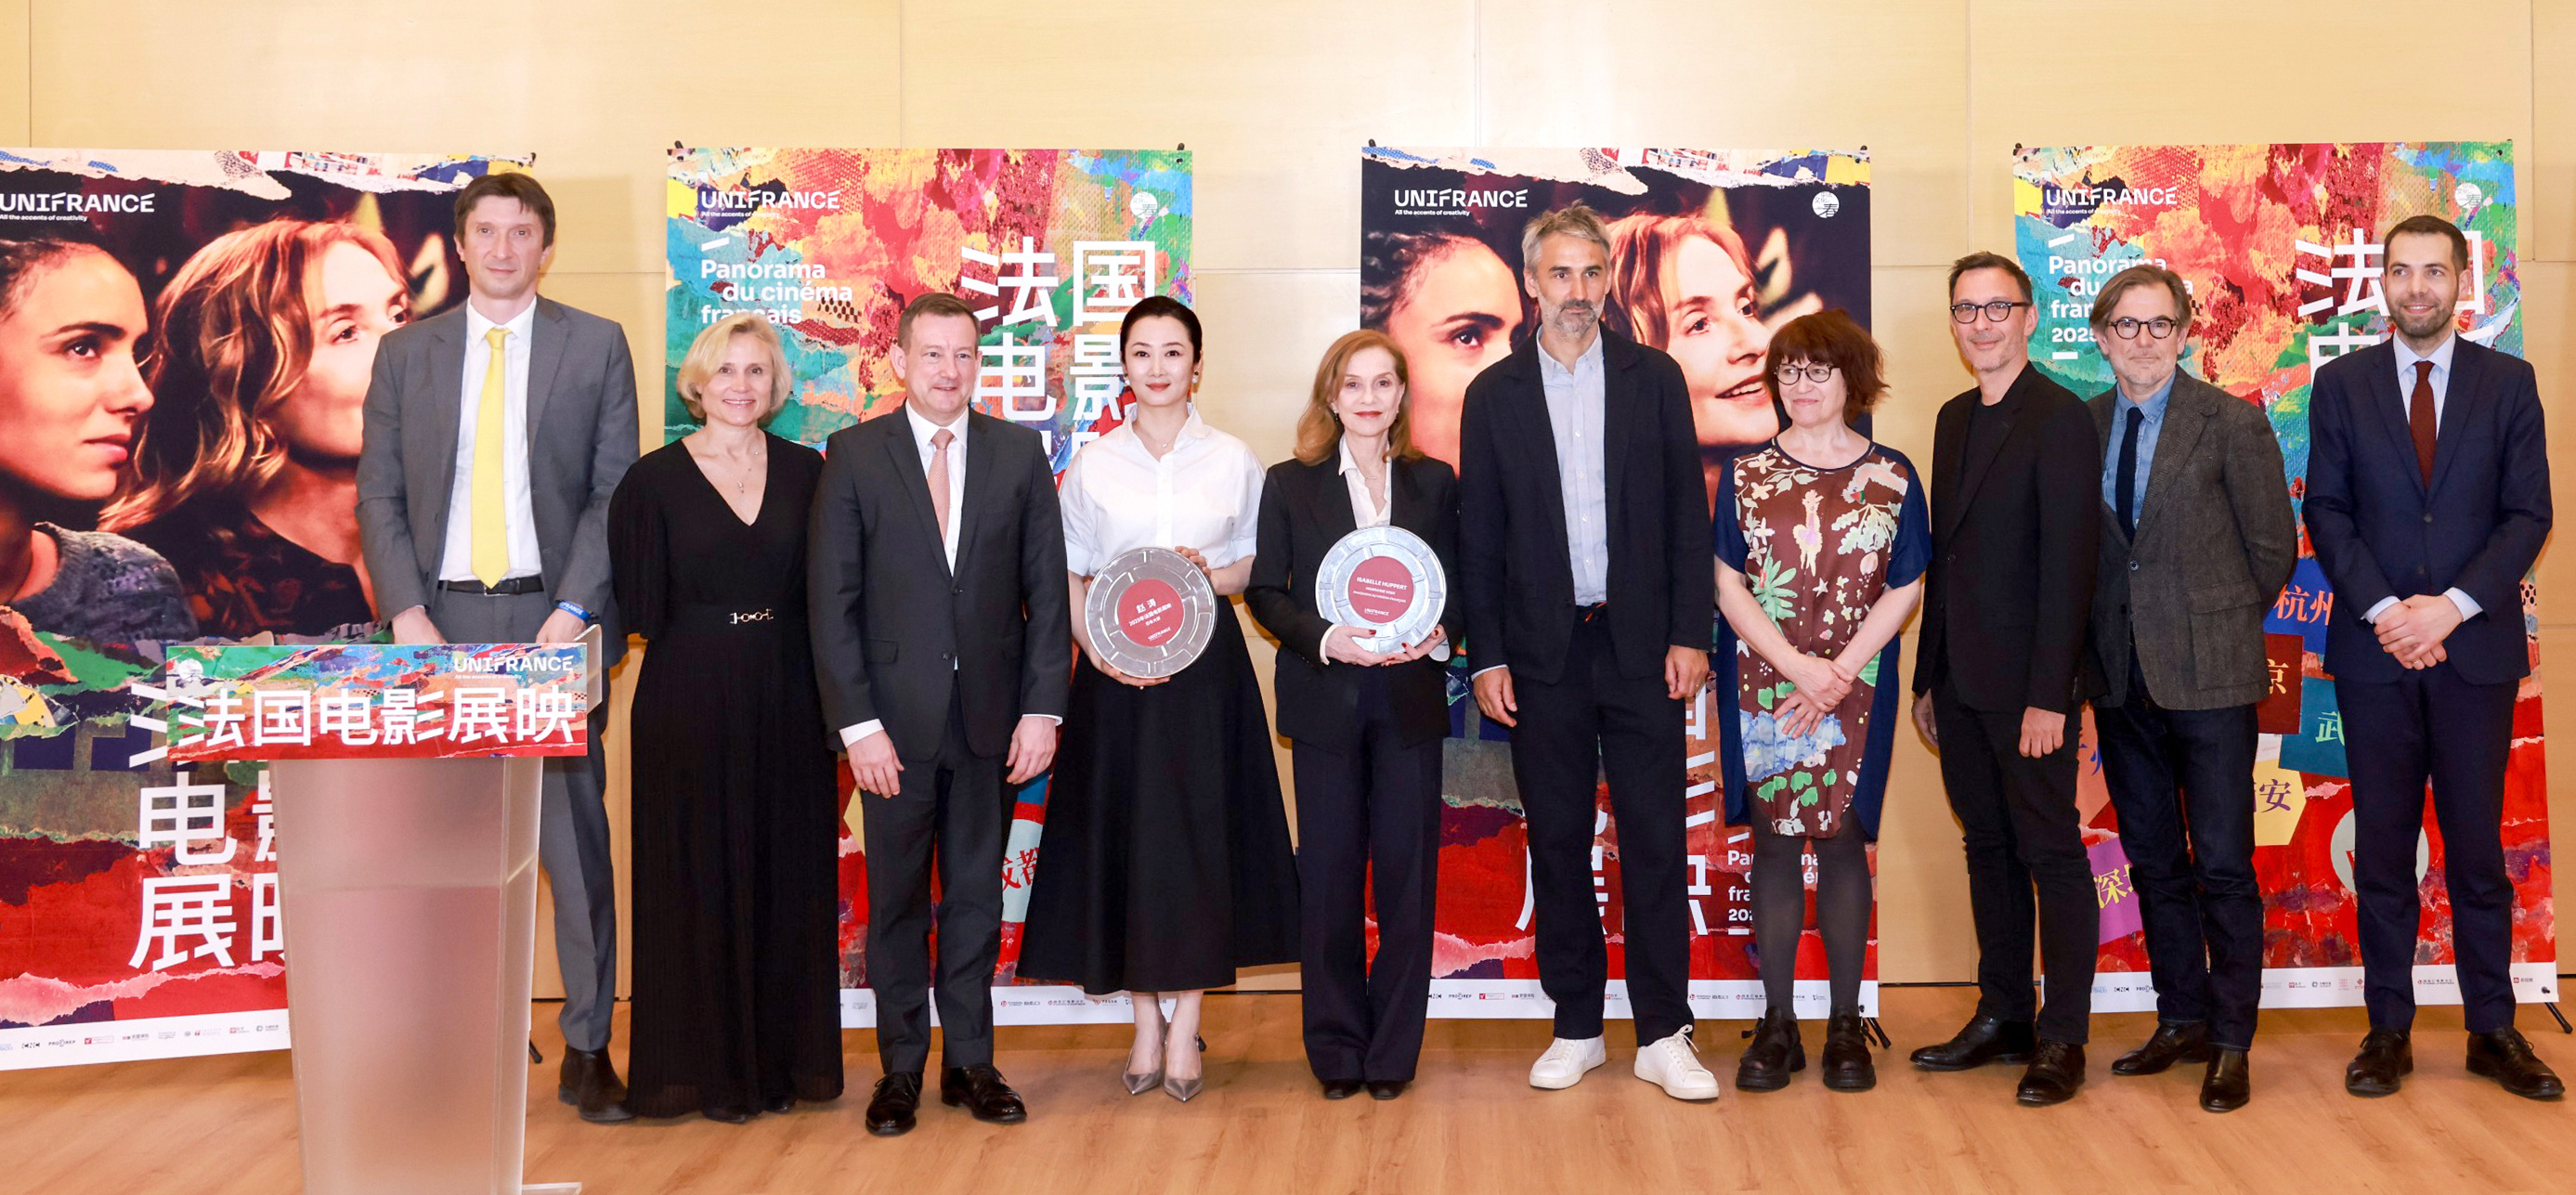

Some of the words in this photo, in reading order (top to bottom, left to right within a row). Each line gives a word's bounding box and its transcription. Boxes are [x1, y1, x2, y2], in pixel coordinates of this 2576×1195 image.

[0, 192, 155, 213] UNIFRANCE
[701, 189, 840, 209] UNIFRANCE
[1394, 188, 1529, 207] UNIFRANCE
[2046, 187, 2178, 206] UNIFRANCE
[56, 214, 88, 223] creativity
[701, 259, 826, 279] Panorama
[722, 281, 755, 302] du
[761, 280, 853, 302] cinéma
[961, 236, 1156, 327] 法国
[2070, 277, 2101, 297] du
[701, 304, 803, 325] fraais
[1357, 577, 1382, 587] ISABELLE
[1382, 581, 1408, 591] HUPPERT
[2272, 584, 2335, 626] 杭州
[454, 656, 574, 673] UNIFRANCE
[178, 684, 576, 745] 法国电影展映
[2315, 710, 2345, 747] 武
[2254, 778, 2291, 813] 安
[2093, 864, 2134, 909] 深
